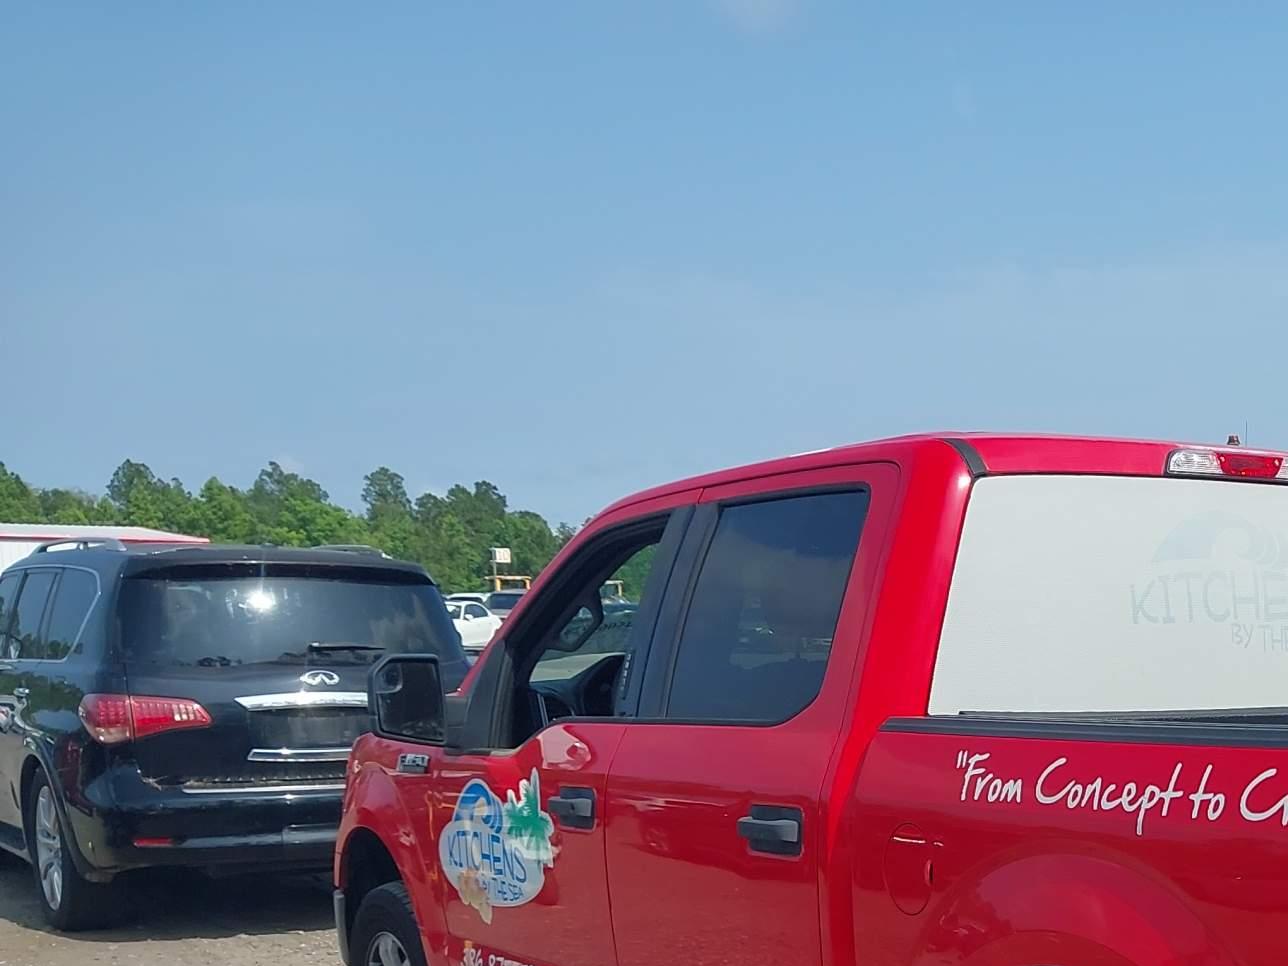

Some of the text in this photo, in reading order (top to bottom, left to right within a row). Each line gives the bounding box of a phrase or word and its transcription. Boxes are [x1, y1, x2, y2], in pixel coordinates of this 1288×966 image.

[1230, 622, 1254, 649] BY
[1035, 756, 1184, 837] Concept
[1188, 763, 1227, 822] to
[447, 829, 528, 884] KITCHENS
